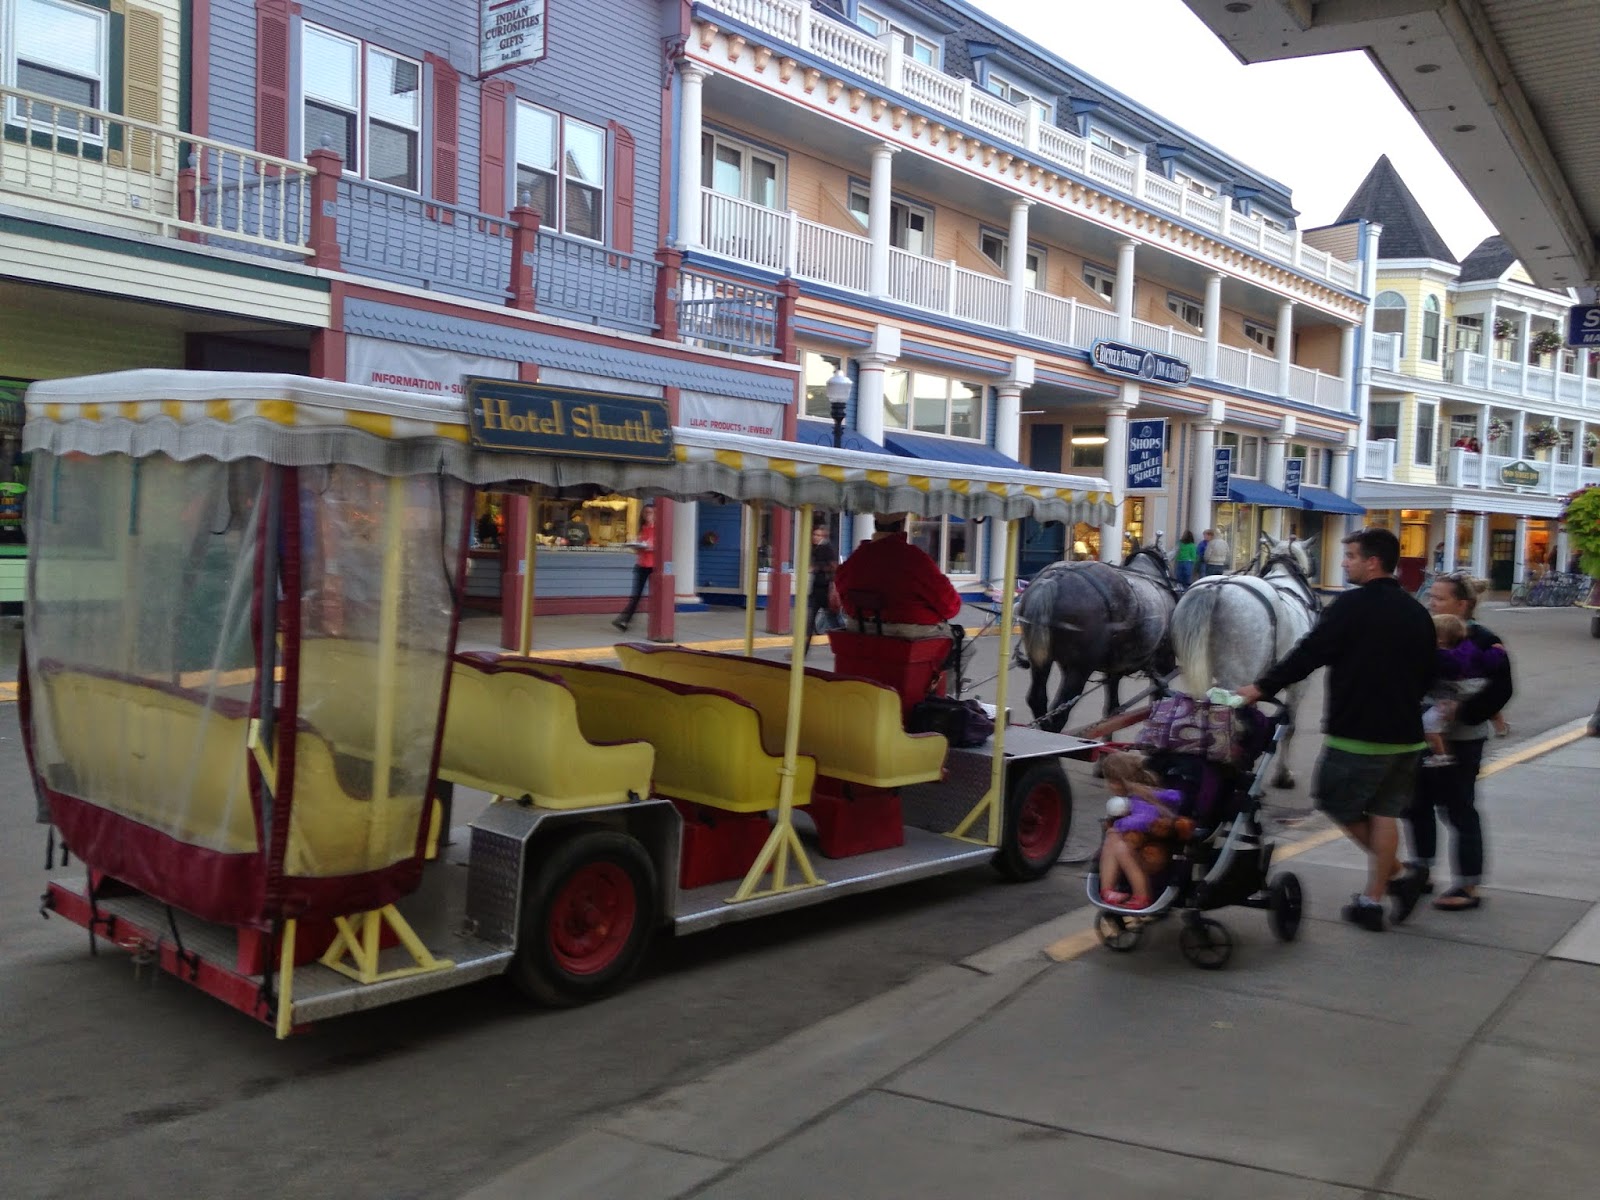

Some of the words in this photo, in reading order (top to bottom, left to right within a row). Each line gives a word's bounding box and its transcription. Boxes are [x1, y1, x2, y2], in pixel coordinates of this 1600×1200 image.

[495, 6, 528, 26] INDIAN
[485, 14, 539, 40] CURIOSITIES
[499, 33, 524, 50] GIFTS
[1099, 344, 1120, 366] BICYCLE
[1120, 349, 1141, 371] STREET
[371, 372, 442, 391] INFORMATION
[479, 396, 565, 436] Hotel
[570, 403, 666, 445] Shuttle
[690, 417, 708, 428] LILAC
[710, 420, 742, 432] PRODUCTS
[747, 425, 773, 435] JEWELRY
[1129, 437, 1162, 452] SHOPS
[1128, 456, 1161, 475] BICYCLE
[1134, 466, 1161, 484] STREET
